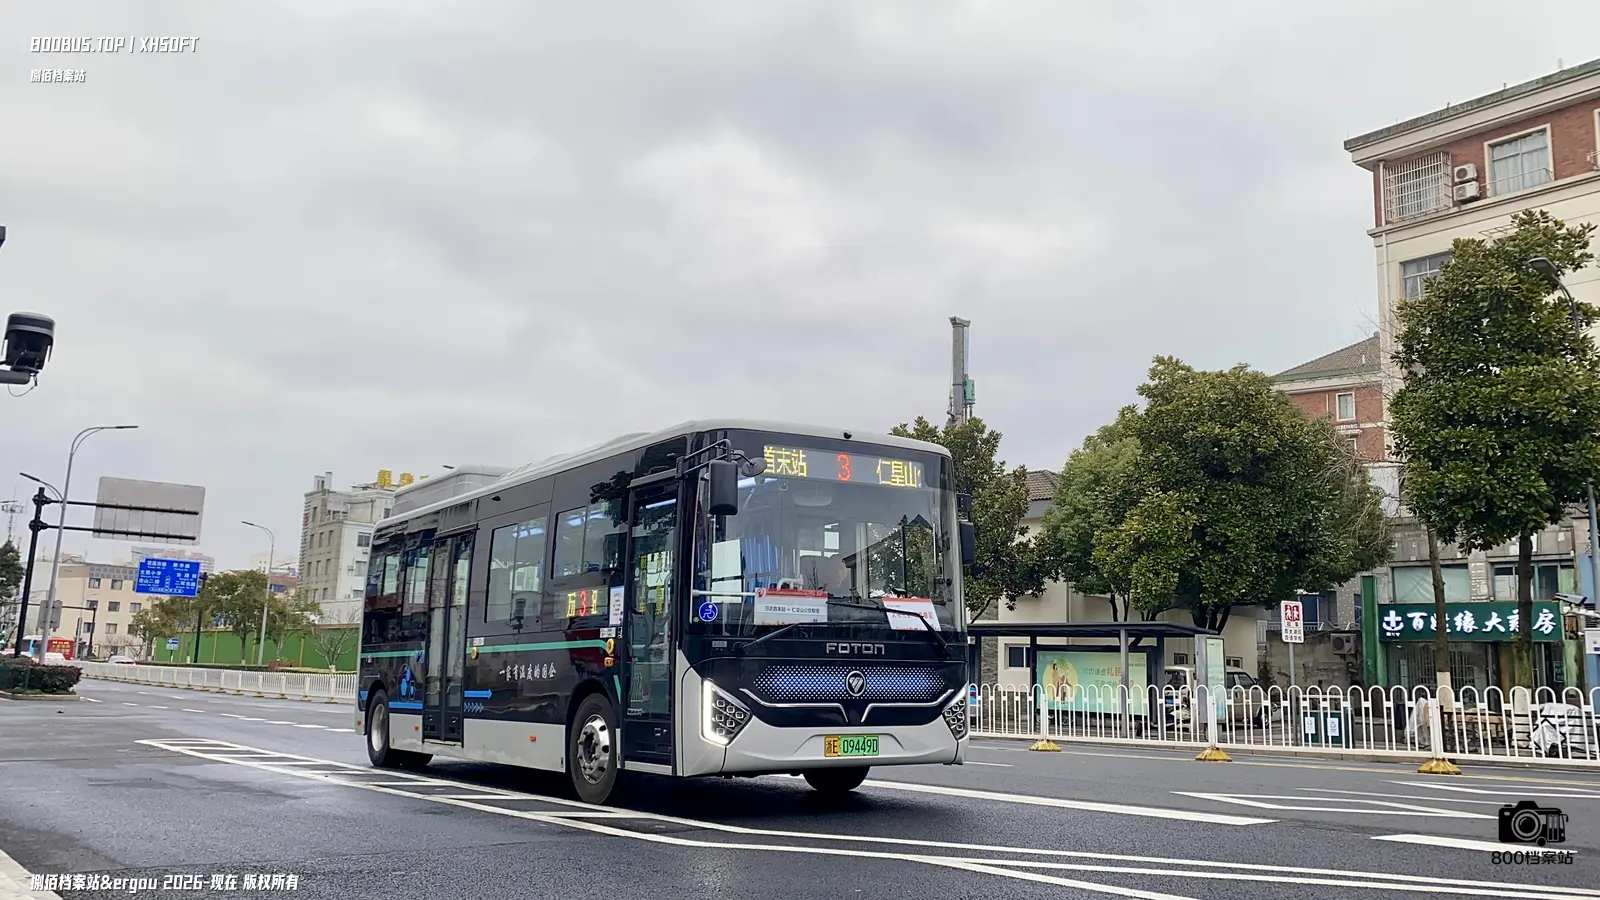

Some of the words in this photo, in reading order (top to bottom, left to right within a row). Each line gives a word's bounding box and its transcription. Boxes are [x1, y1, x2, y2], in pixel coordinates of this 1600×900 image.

[764, 445, 807, 477] 首末站
[837, 453, 852, 481] 3
[877, 458, 922, 488] 仁皇山
[580, 590, 587, 617] 3
[826, 642, 885, 655] FOTON
